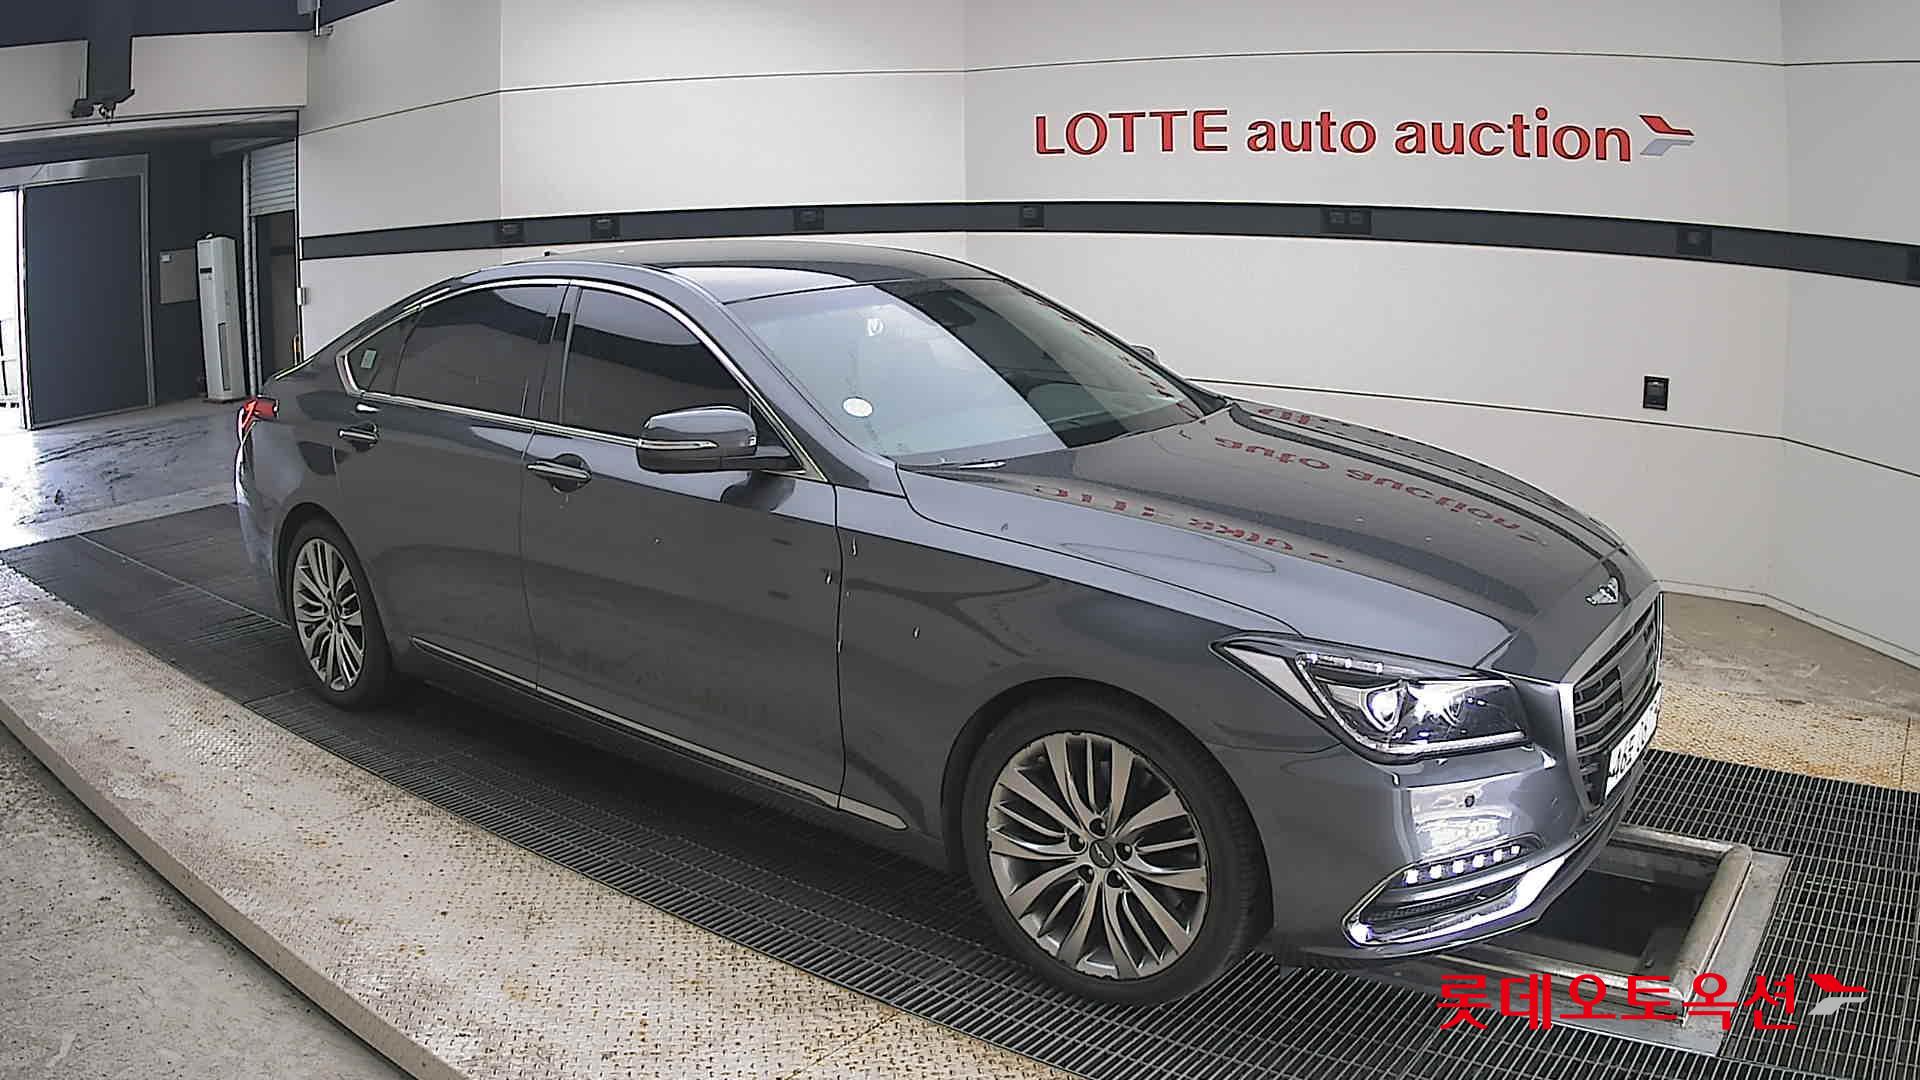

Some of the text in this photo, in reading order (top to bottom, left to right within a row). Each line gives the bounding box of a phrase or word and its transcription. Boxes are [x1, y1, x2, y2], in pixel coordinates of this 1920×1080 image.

[1034, 106, 1632, 163] LOTTE auto auction
